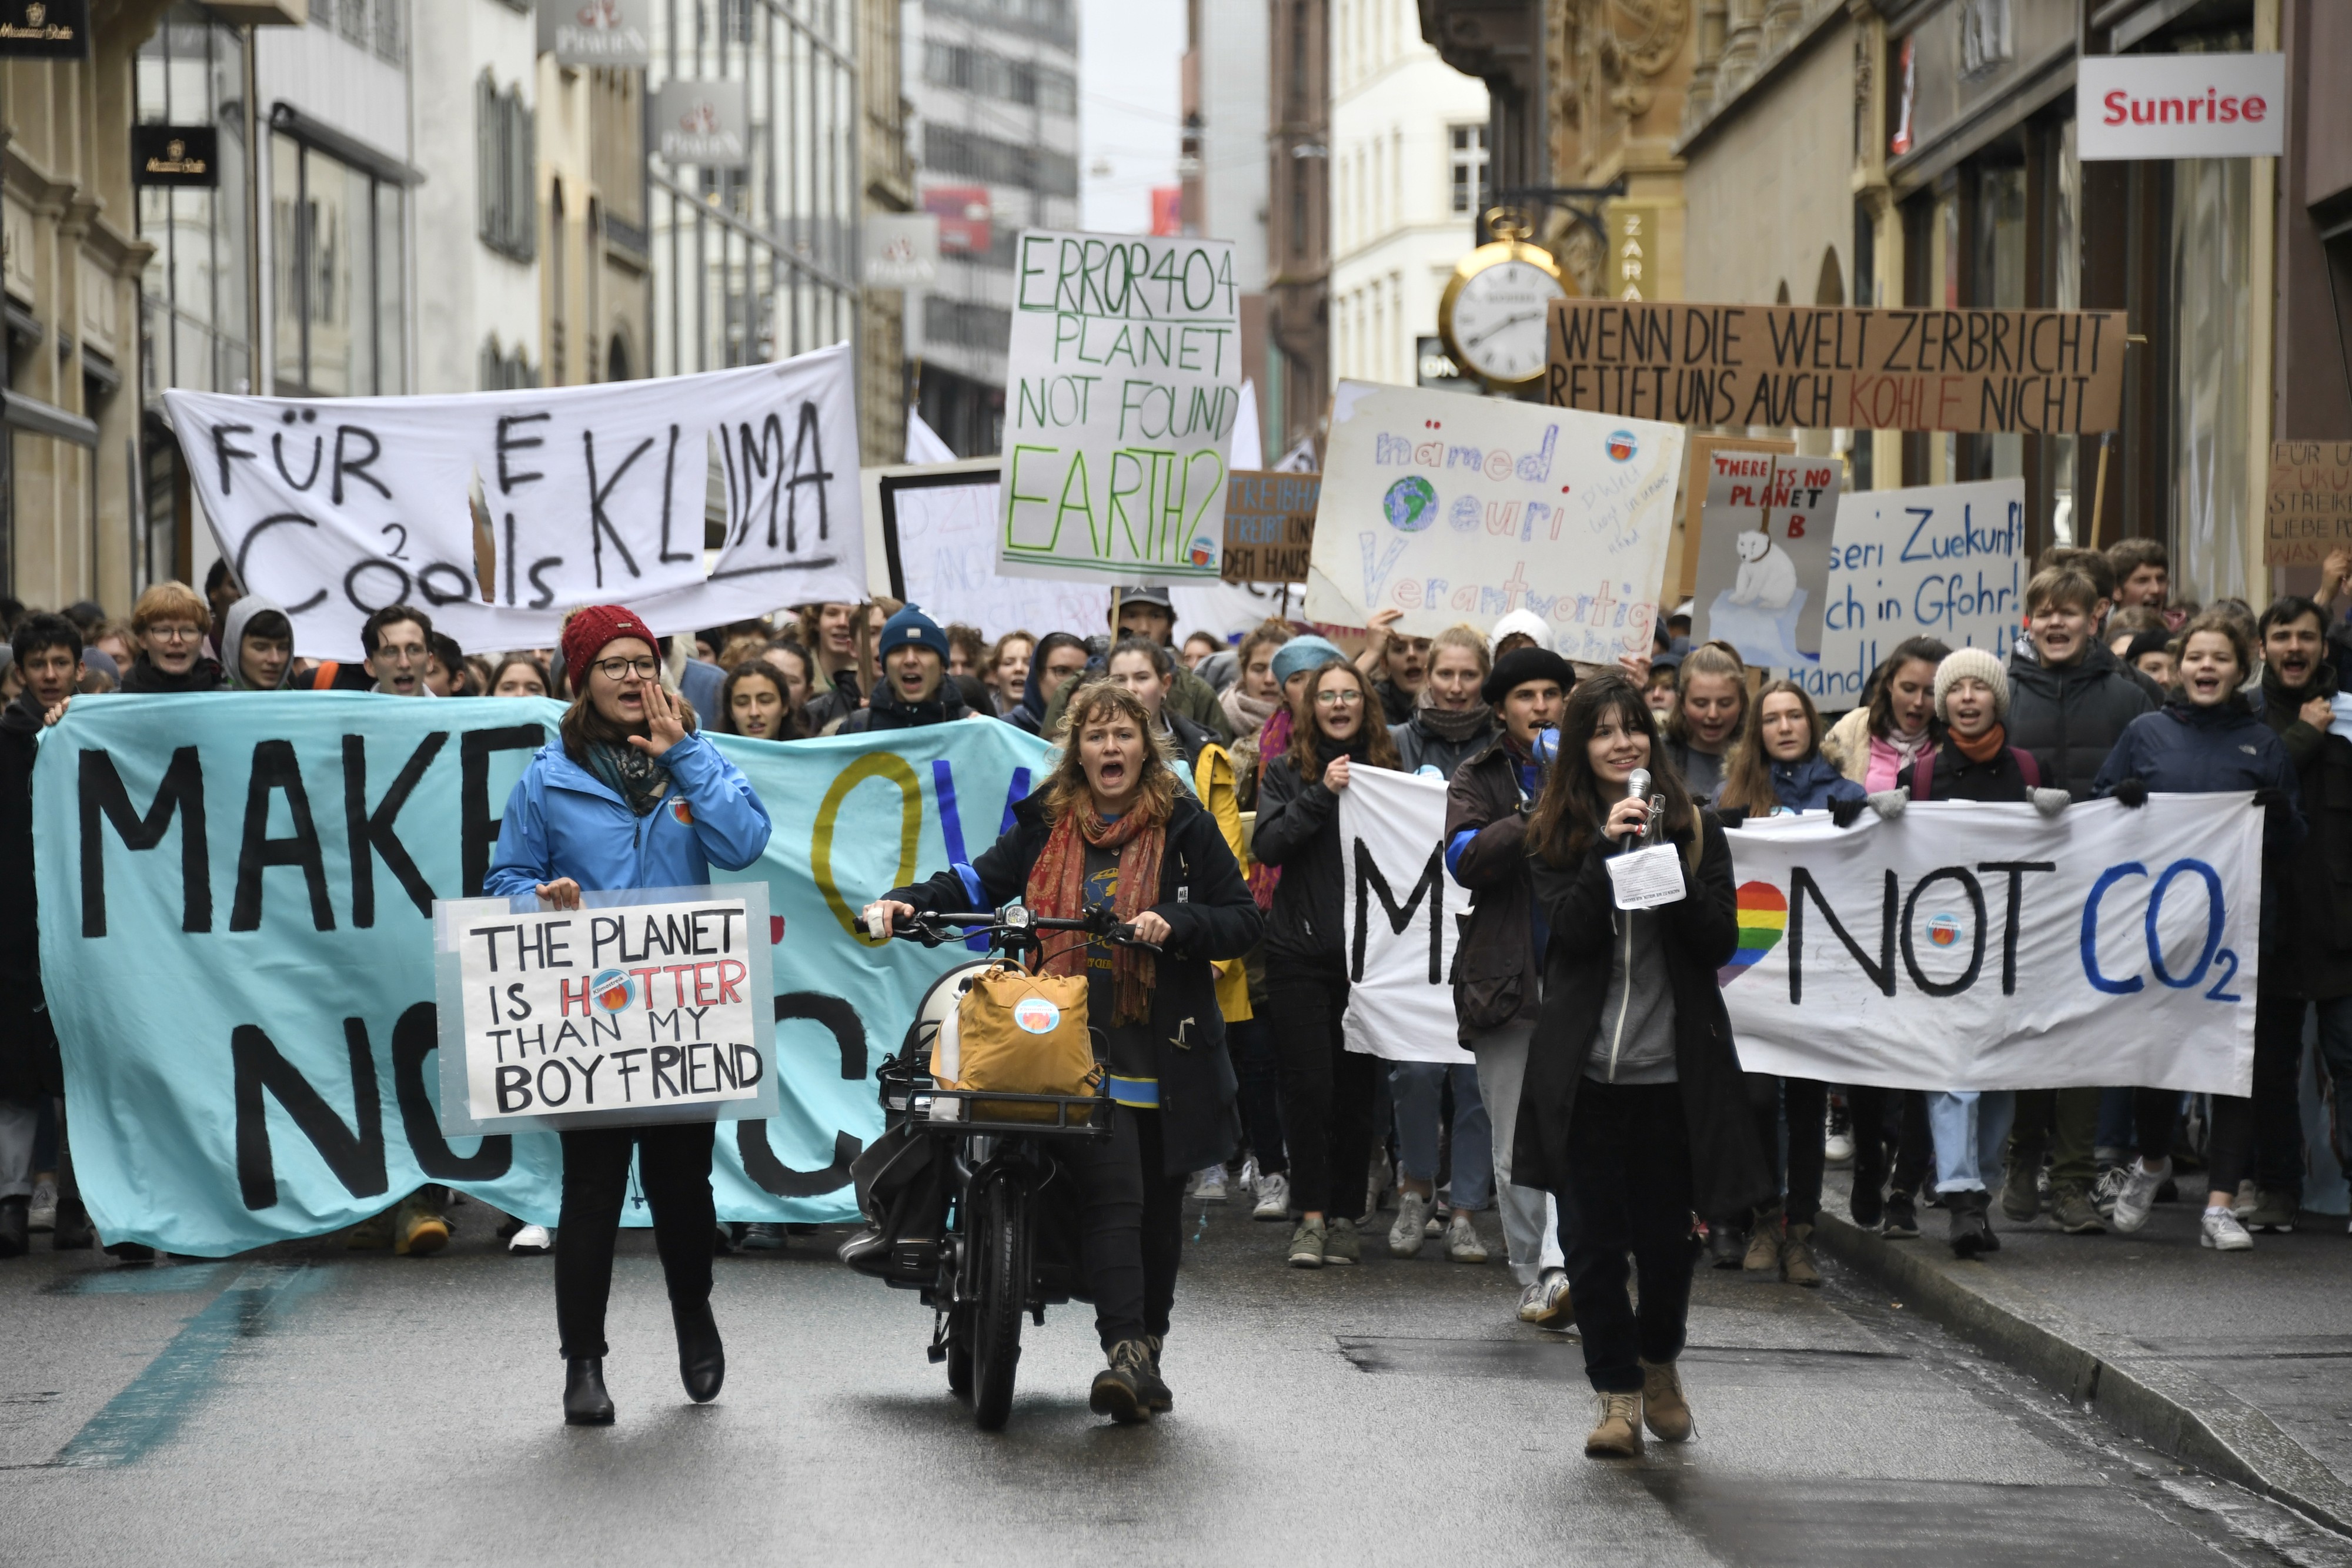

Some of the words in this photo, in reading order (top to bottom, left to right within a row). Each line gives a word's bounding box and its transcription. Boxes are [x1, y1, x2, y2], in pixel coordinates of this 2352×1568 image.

[2103, 86, 2268, 126] Sunrise
[1620, 213, 1643, 302] ZARA
[1054, 314, 1232, 377] PLANET
[1559, 306, 1672, 363] WENN
[1683, 309, 1745, 366] DIE
[1768, 310, 1874, 369] WELT
[1883, 312, 2111, 375] ZERBRICHT
[1018, 375, 1102, 428] NOT
[1120, 380, 1239, 442] FOUND
[1675, 368, 1736, 426] UNS
[1744, 372, 1833, 427] AUCH
[1849, 373, 1965, 431] KOHLE
[1980, 375, 2089, 434] NICHT
[211, 408, 392, 505] FÜR
[1715, 457, 1768, 479] THERE
[1776, 469, 1797, 487] IS
[1804, 468, 1831, 487] NO
[2275, 441, 2320, 466] FÜR
[583, 401, 834, 589] KLIMA
[1729, 485, 1823, 510] PLANET
[1787, 514, 1806, 539] B
[1829, 509, 1883, 570] seri
[1900, 501, 2023, 563] Zuekunft
[1877, 579, 1902, 620] in
[1915, 560, 2020, 633] Gfohr!
[470, 920, 573, 972] THE
[591, 908, 744, 969] PLANET
[1788, 860, 2056, 1005] NOT
[489, 982, 532, 1025] IS
[592, 975, 624, 995] Klimastreik
[486, 1012, 622, 1063] THAN
[649, 1006, 709, 1042] MY
